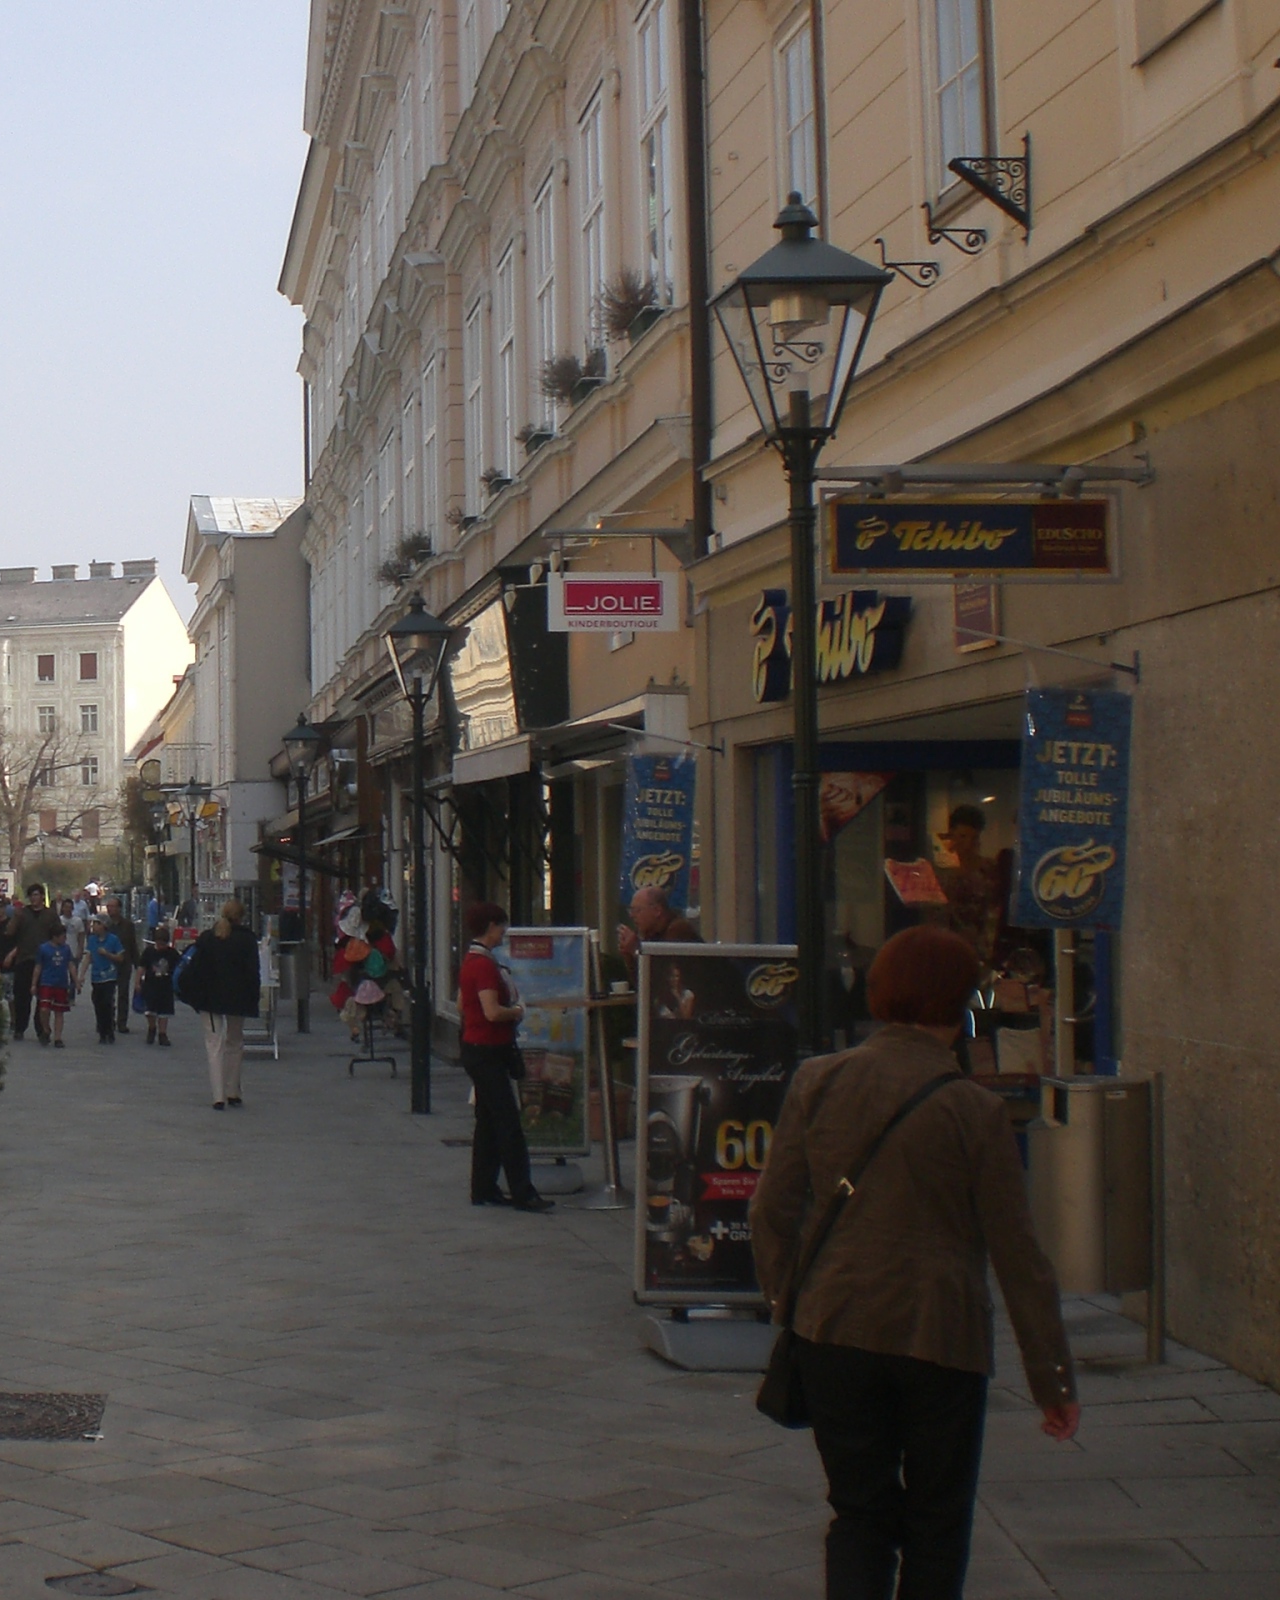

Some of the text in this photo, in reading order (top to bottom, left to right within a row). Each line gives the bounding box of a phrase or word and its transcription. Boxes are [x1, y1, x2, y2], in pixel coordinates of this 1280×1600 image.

[893, 520, 1018, 551] Tchibo
[568, 620, 659, 628] KINDERBOUTIQUE
[1035, 740, 1118, 768] JETZT:
[1057, 770, 1099, 786] TOLLE
[635, 788, 686, 806] JETZT:
[1035, 788, 1118, 806] JUBILÄUMS-
[1039, 808, 1112, 826] ANGEBOTE
